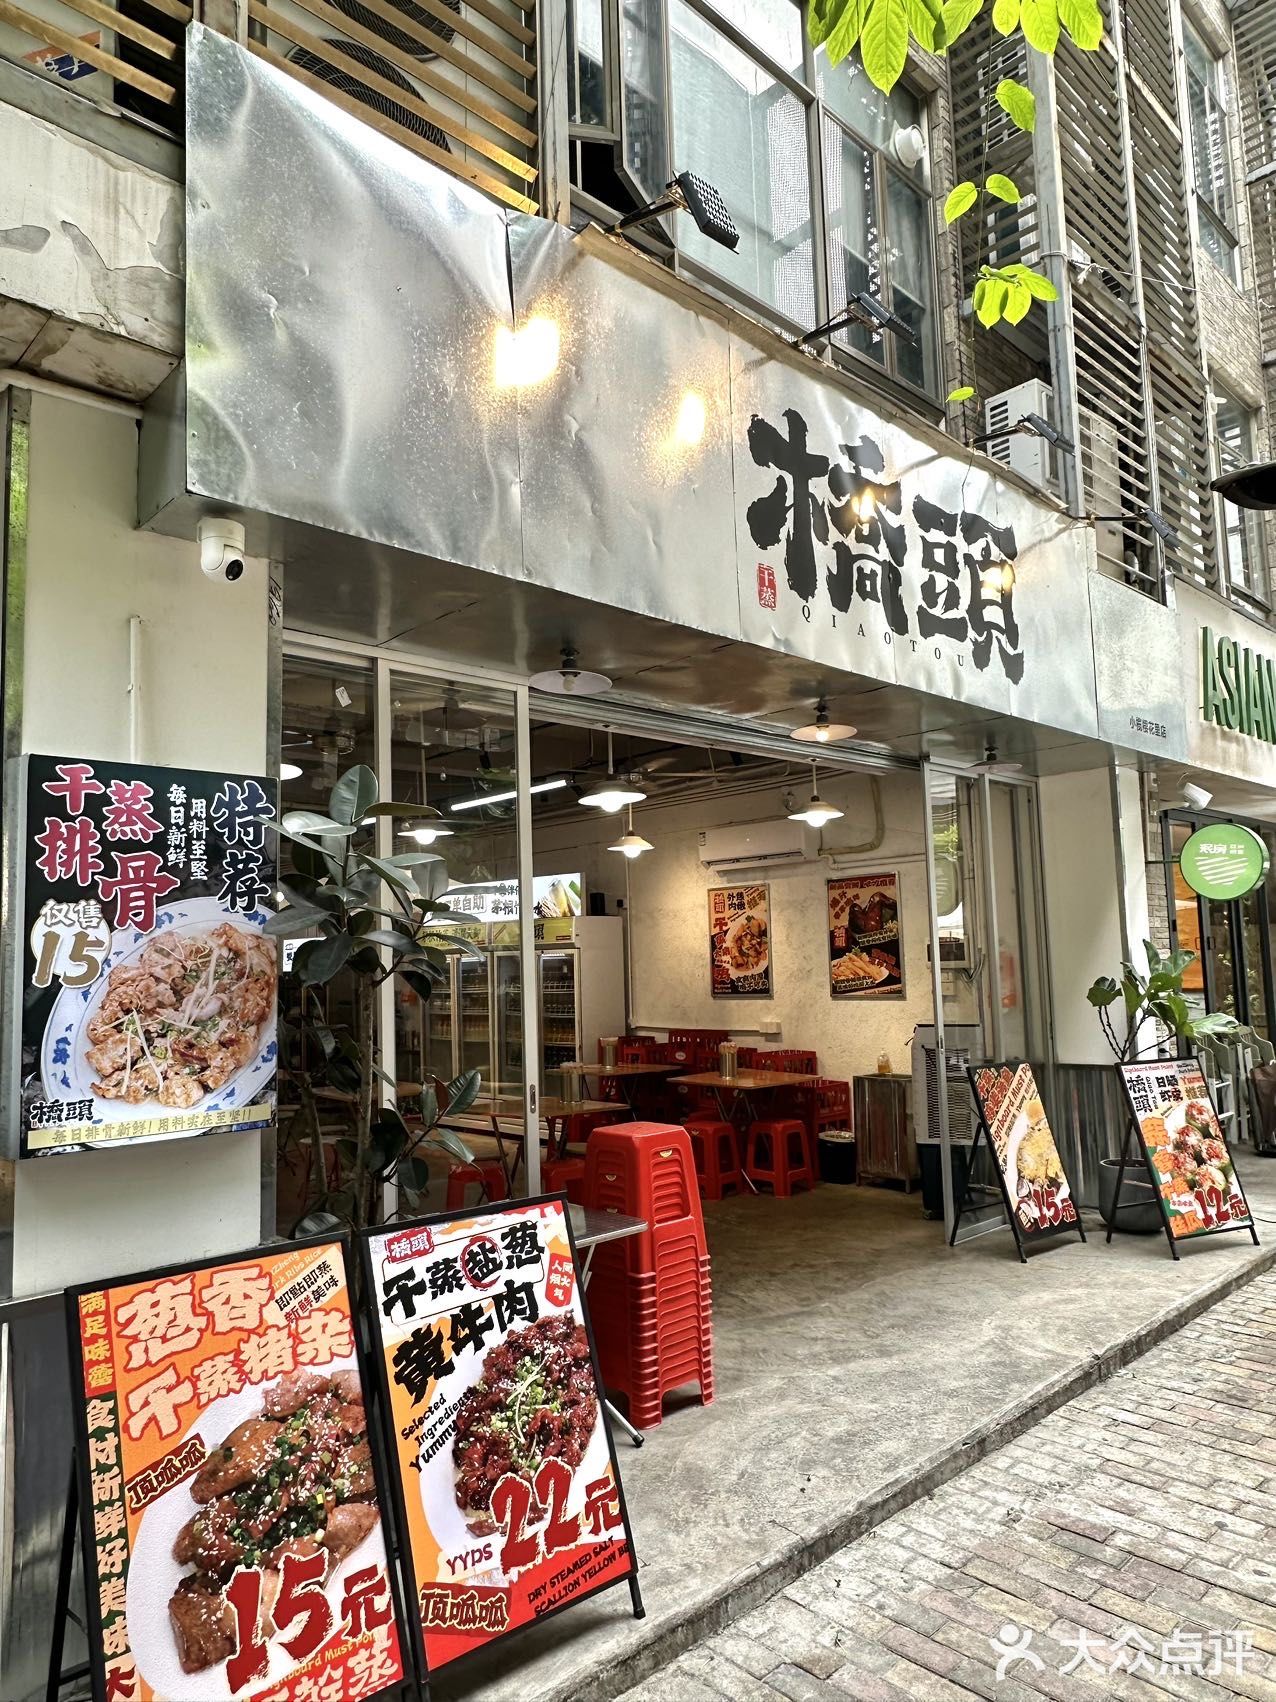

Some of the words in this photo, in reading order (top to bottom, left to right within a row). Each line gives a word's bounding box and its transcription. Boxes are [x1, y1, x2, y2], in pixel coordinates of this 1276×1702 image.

[746, 408, 1024, 685] 橋頭
[210, 780, 276, 914] 特荐
[41, 898, 102, 929] 仅售
[32, 929, 106, 989] 15
[30, 1098, 95, 1124] 橋頭
[1194, 1185, 1249, 1230] 12元
[117, 1265, 274, 1369] 葱香
[392, 1281, 539, 1408] 黄牛肉
[123, 1309, 354, 1442] 干蒸猪杂
[401, 1393, 446, 1440] Selected
[126, 1444, 207, 1508] 顶呱呱
[492, 1457, 621, 1573] 22元
[447, 1546, 493, 1576] YYDS
[527, 1582, 548, 1604] DRY
[549, 1553, 592, 1589] STEAMED
[592, 1535, 614, 1557] SALT
[534, 1579, 582, 1616] SCALLION
[580, 1551, 617, 1583] YELLOW
[223, 1551, 395, 1695] 15元
[421, 1586, 509, 1632] 顶呱呱
